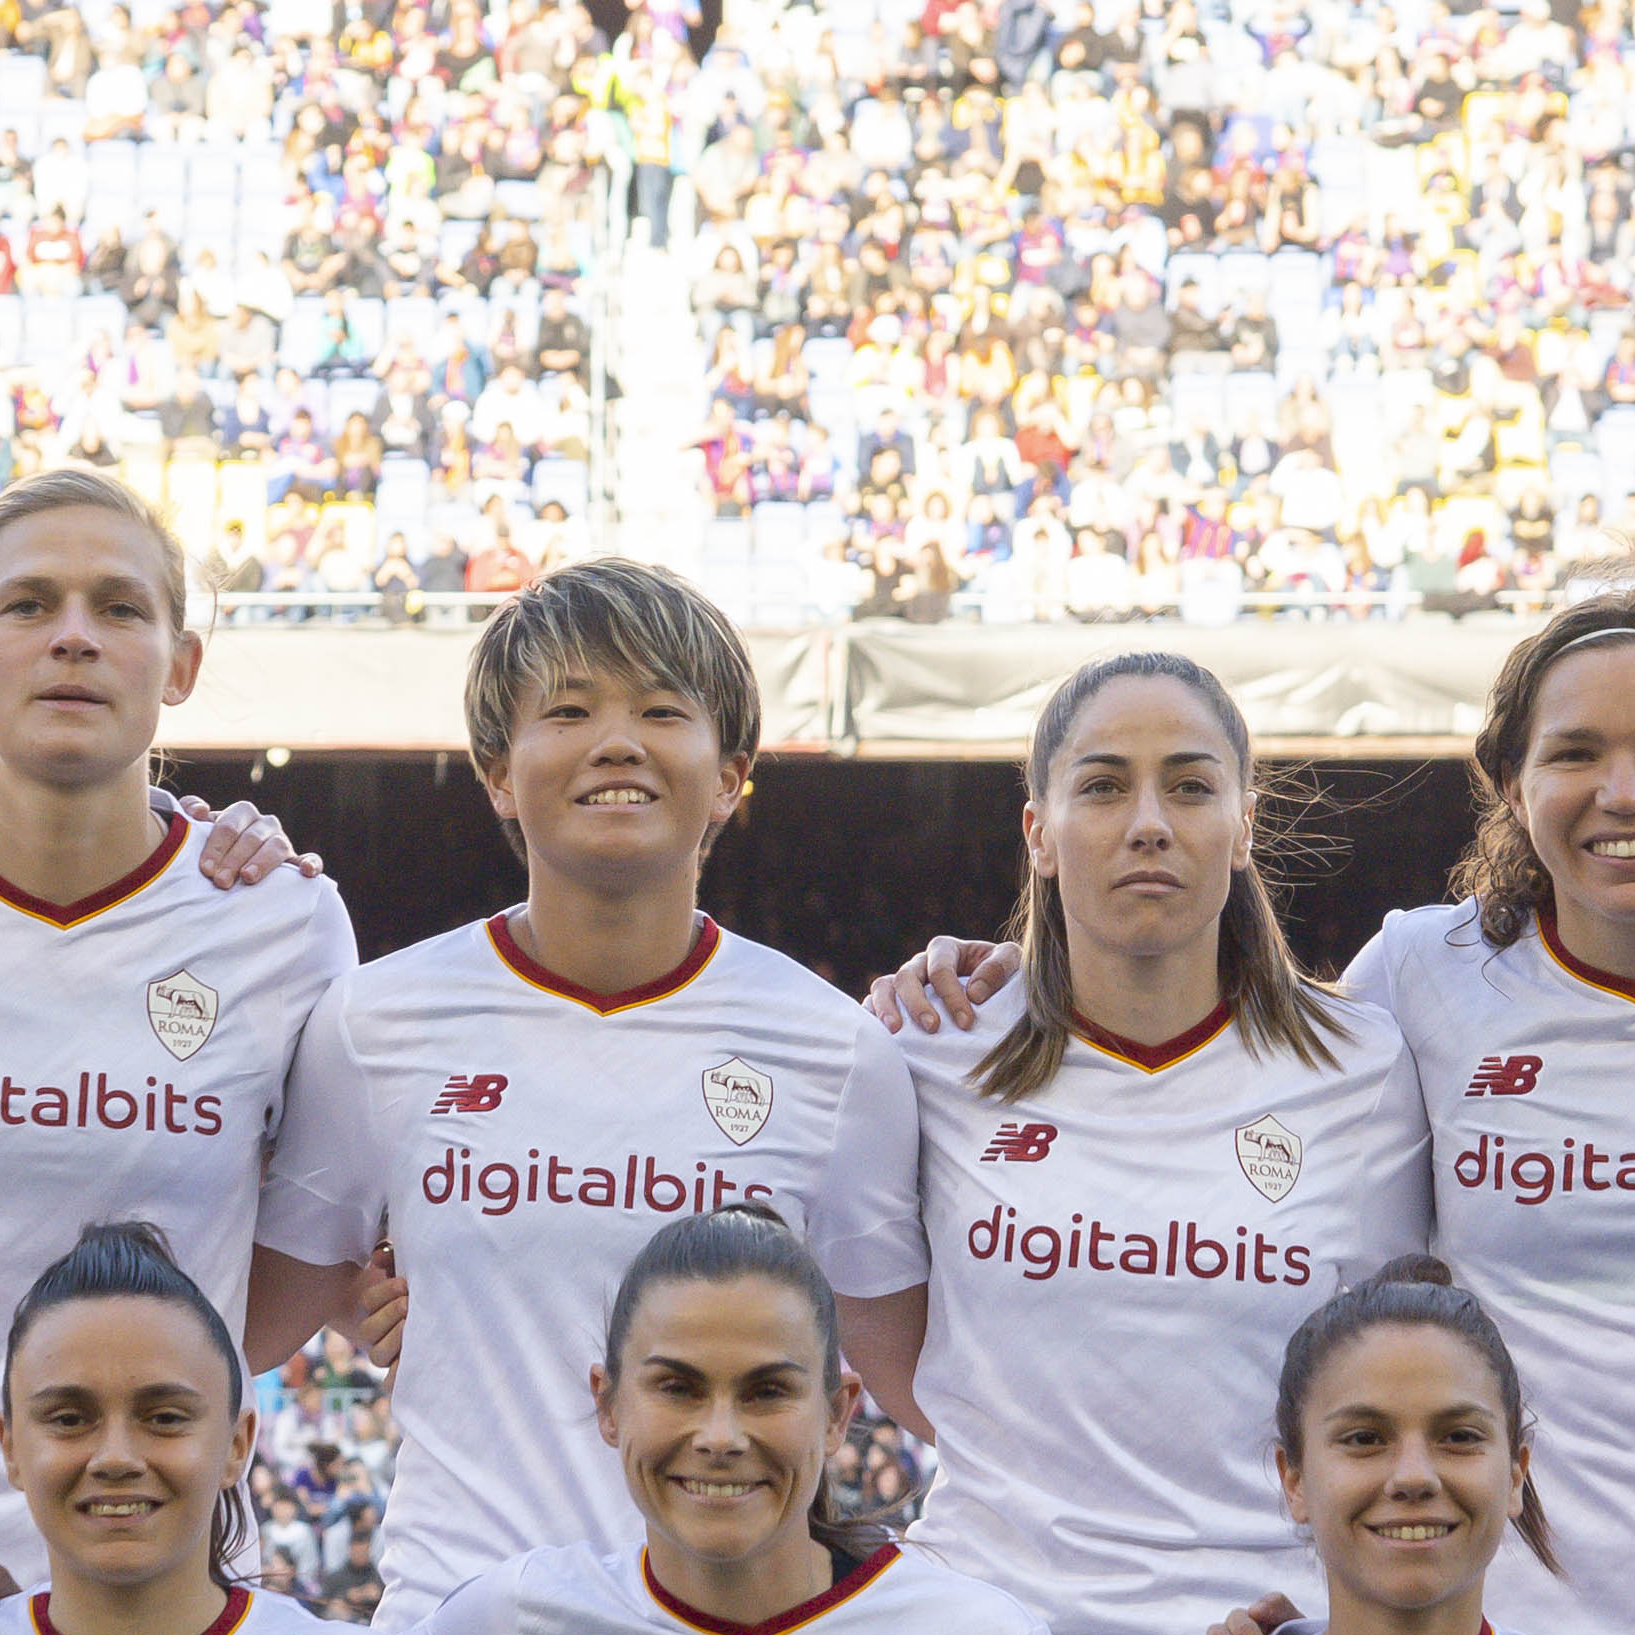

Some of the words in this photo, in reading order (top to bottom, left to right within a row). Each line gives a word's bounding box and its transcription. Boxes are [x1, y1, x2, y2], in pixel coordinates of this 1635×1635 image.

[158, 1020, 206, 1037] ROMA
[715, 1106, 763, 1122] ROMA
[1248, 1164, 1294, 1181] ROMA
[1264, 1182, 1283, 1191] 1927
[968, 1205, 1311, 1286] digitalbits
